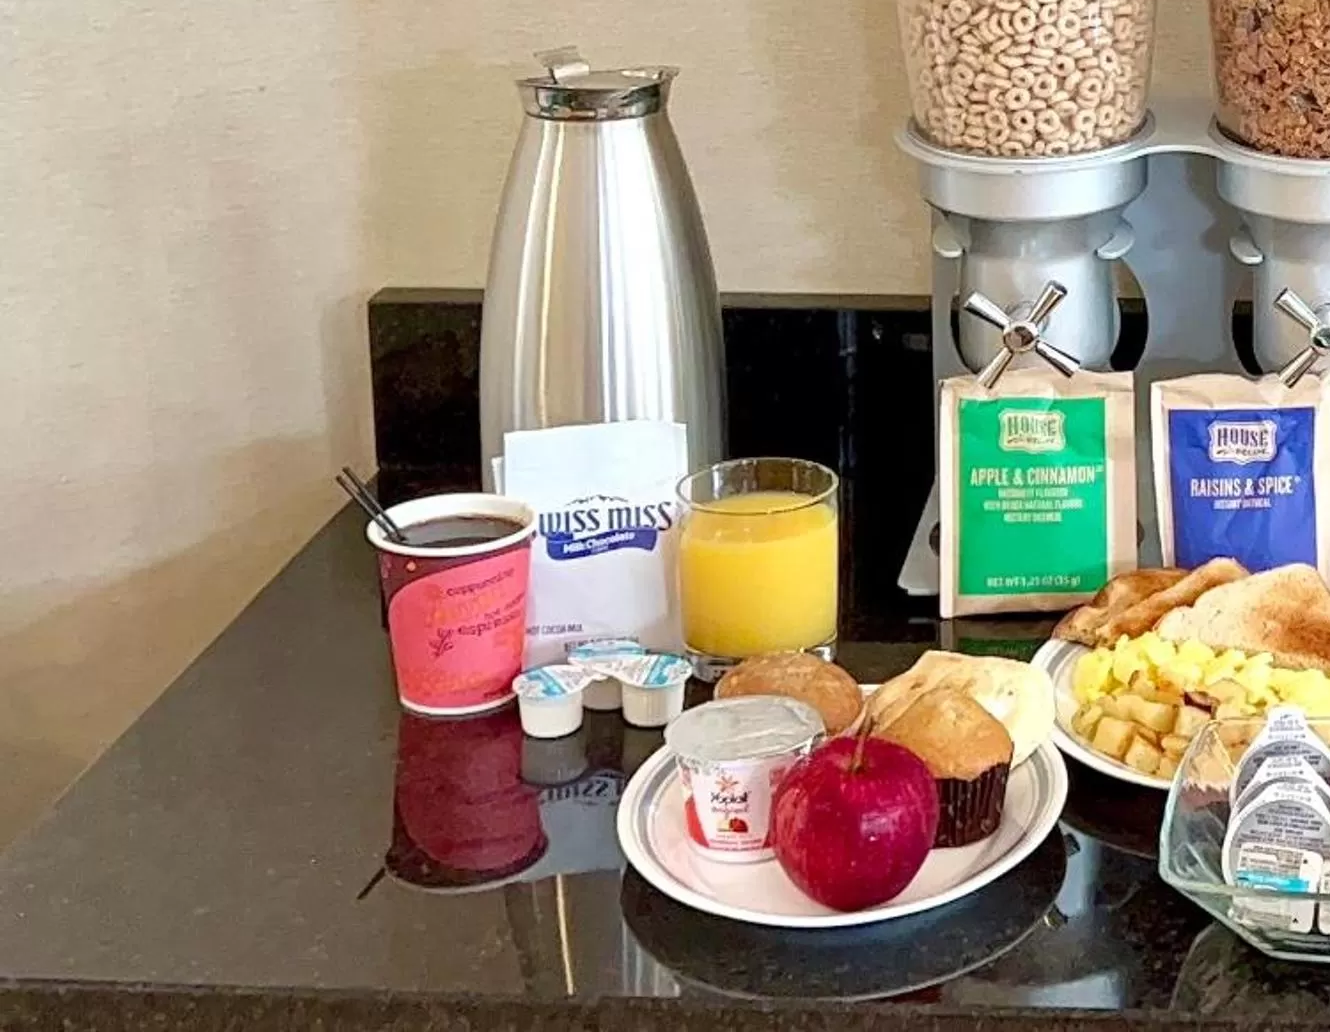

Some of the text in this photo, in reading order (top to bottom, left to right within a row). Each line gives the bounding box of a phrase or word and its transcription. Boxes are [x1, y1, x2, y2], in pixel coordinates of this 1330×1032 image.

[1217, 427, 1269, 447] HOUSE
[970, 465, 1096, 486] APPLE & CINNAMON
[1190, 476, 1294, 497] RAISINS & SPICE
[538, 507, 601, 537] WISS
[562, 542, 584, 555] Milk
[586, 531, 636, 550] Chocolate
